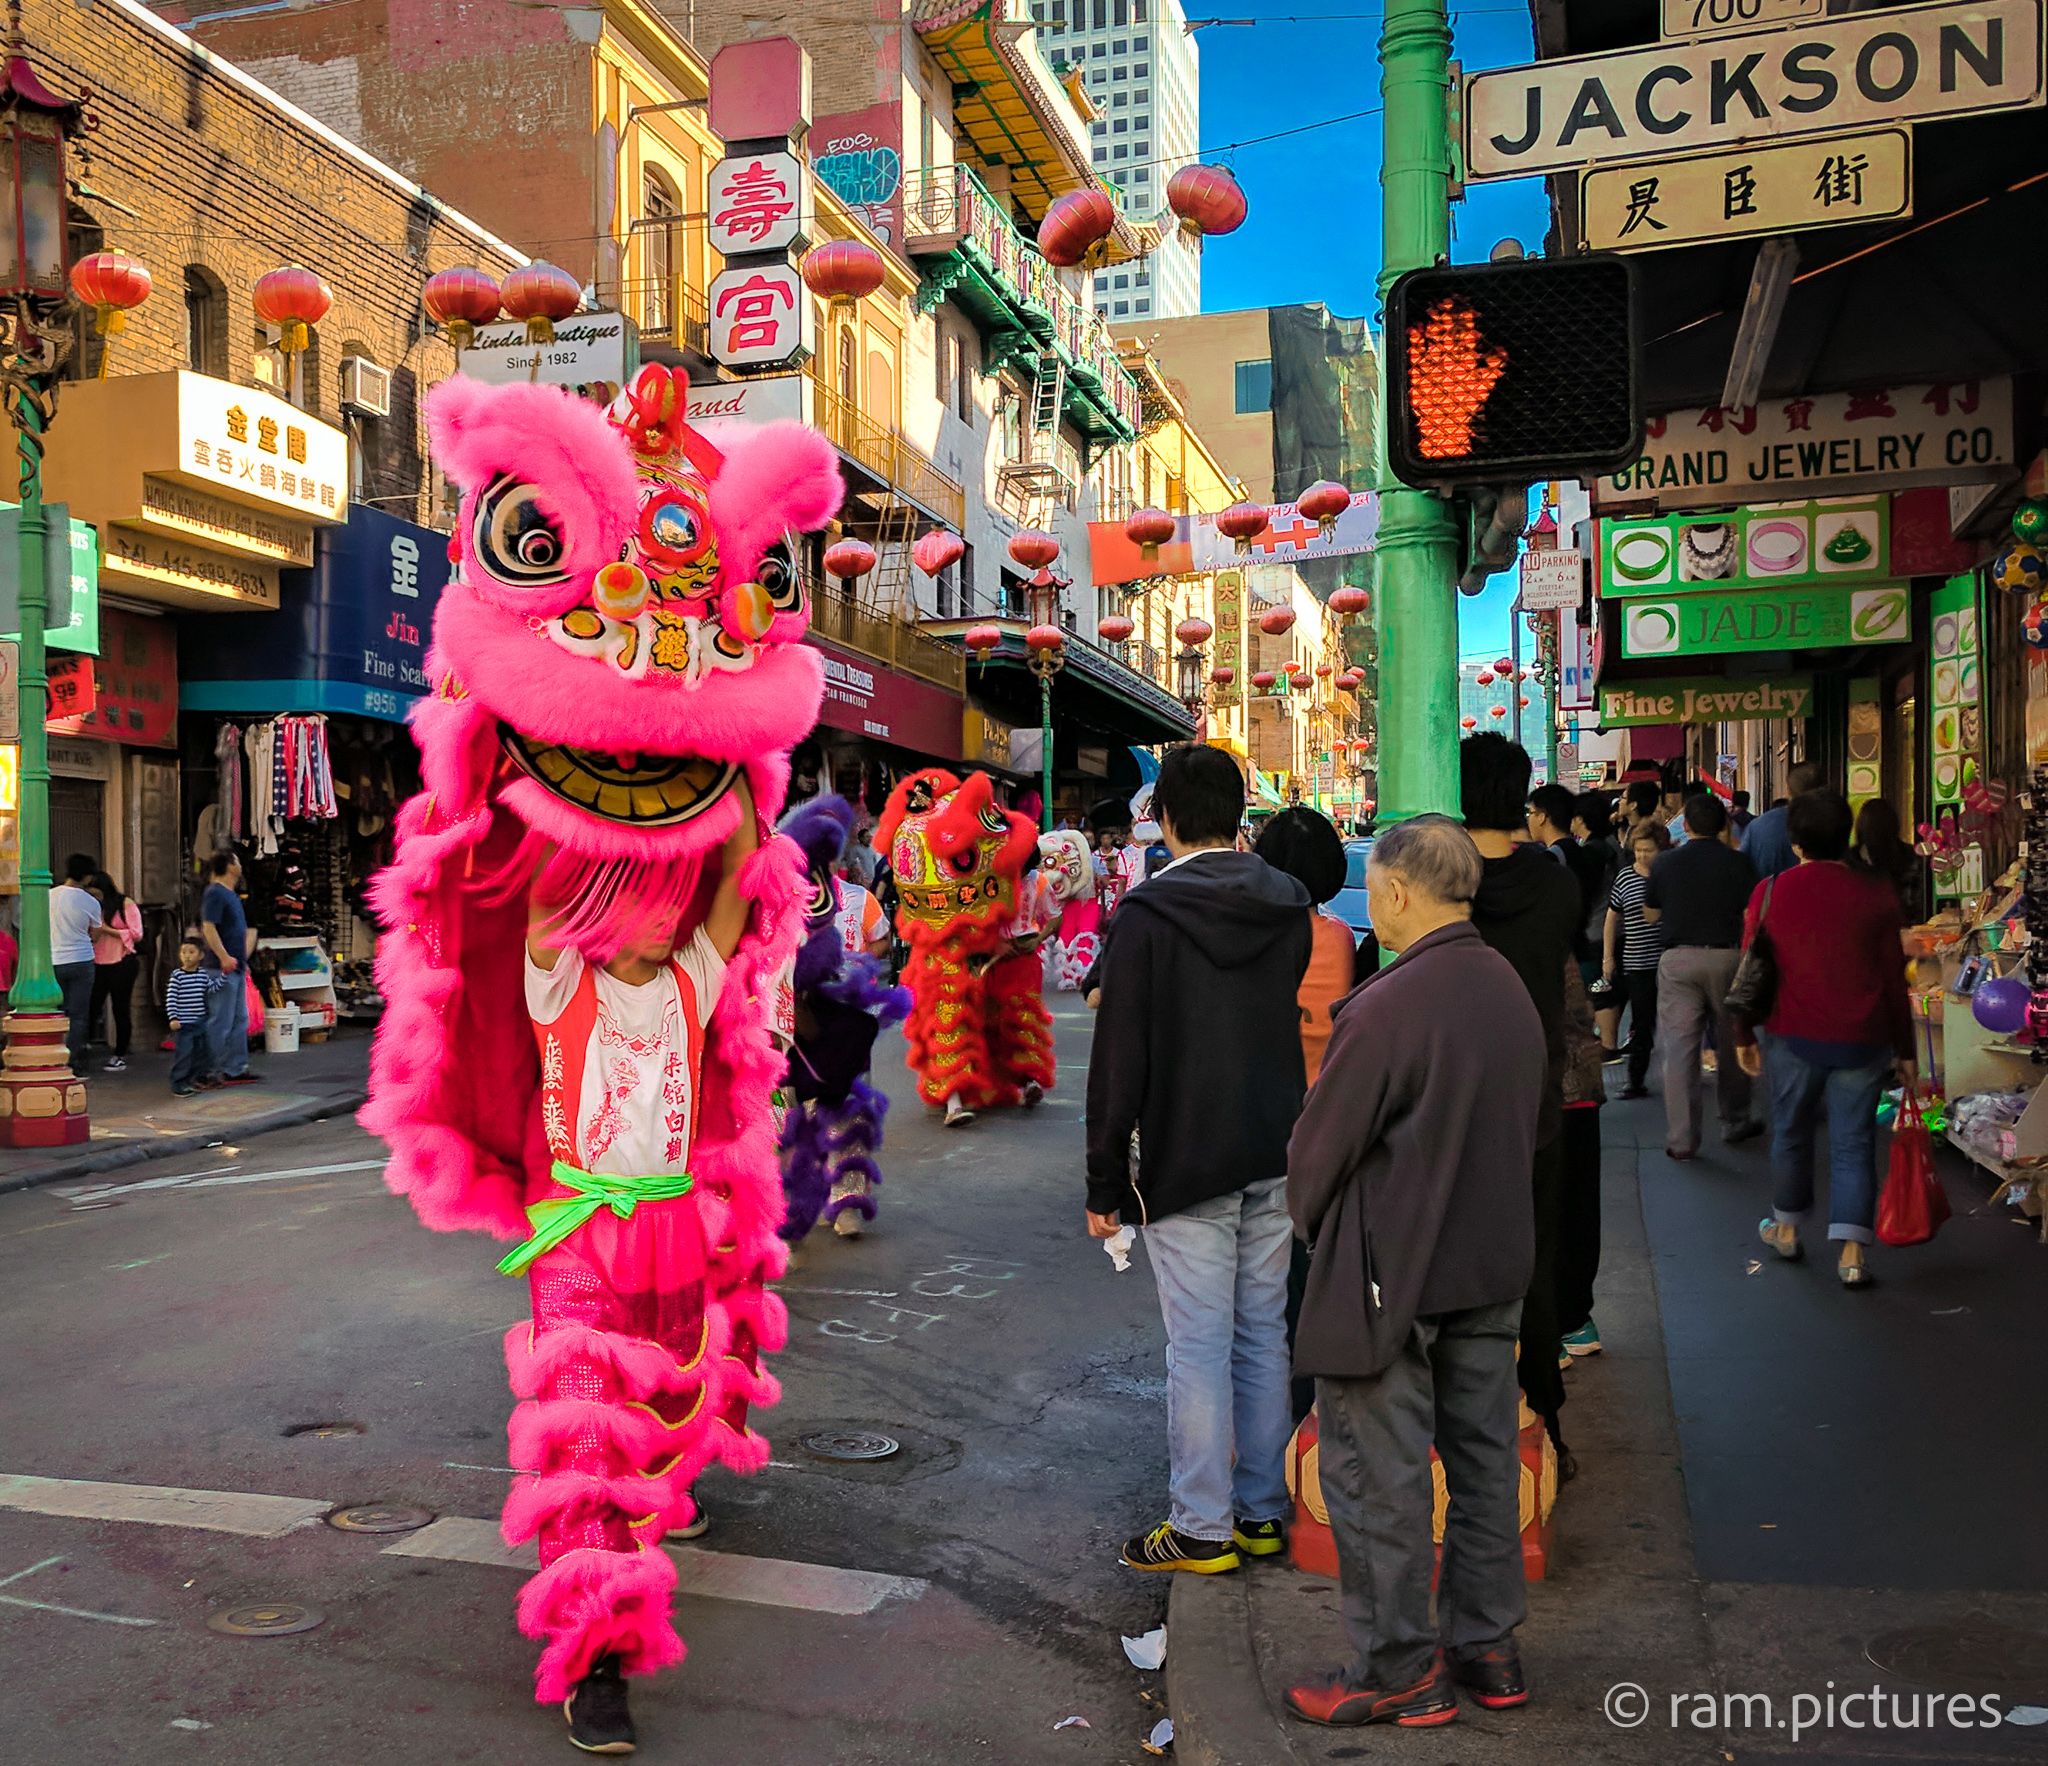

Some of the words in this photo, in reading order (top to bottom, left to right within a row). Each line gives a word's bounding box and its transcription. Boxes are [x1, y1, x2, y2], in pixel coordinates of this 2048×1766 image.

[1685, 0, 1761, 27] 700
[1490, 18, 2004, 156] JACKSON
[550, 325, 620, 347] outique
[507, 355, 542, 369] Since
[547, 352, 577, 366] 1982
[1611, 450, 1728, 491] GRAND
[1748, 432, 1925, 482] JEWELRY
[1945, 427, 2002, 466] CO.
[145, 484, 174, 518] HONG
[178, 494, 204, 528] KONG
[1524, 553, 1540, 570] NO
[1542, 554, 1579, 568] PARKING
[1526, 572, 1533, 584] 2
[1557, 571, 1564, 582] 6
[386, 612, 420, 647] Jin
[1688, 600, 1812, 645] JADE
[363, 650, 395, 679] Fine
[363, 691, 397, 714] #956
[1605, 690, 1675, 719] Fine
[1680, 684, 1810, 722] Jewelry
